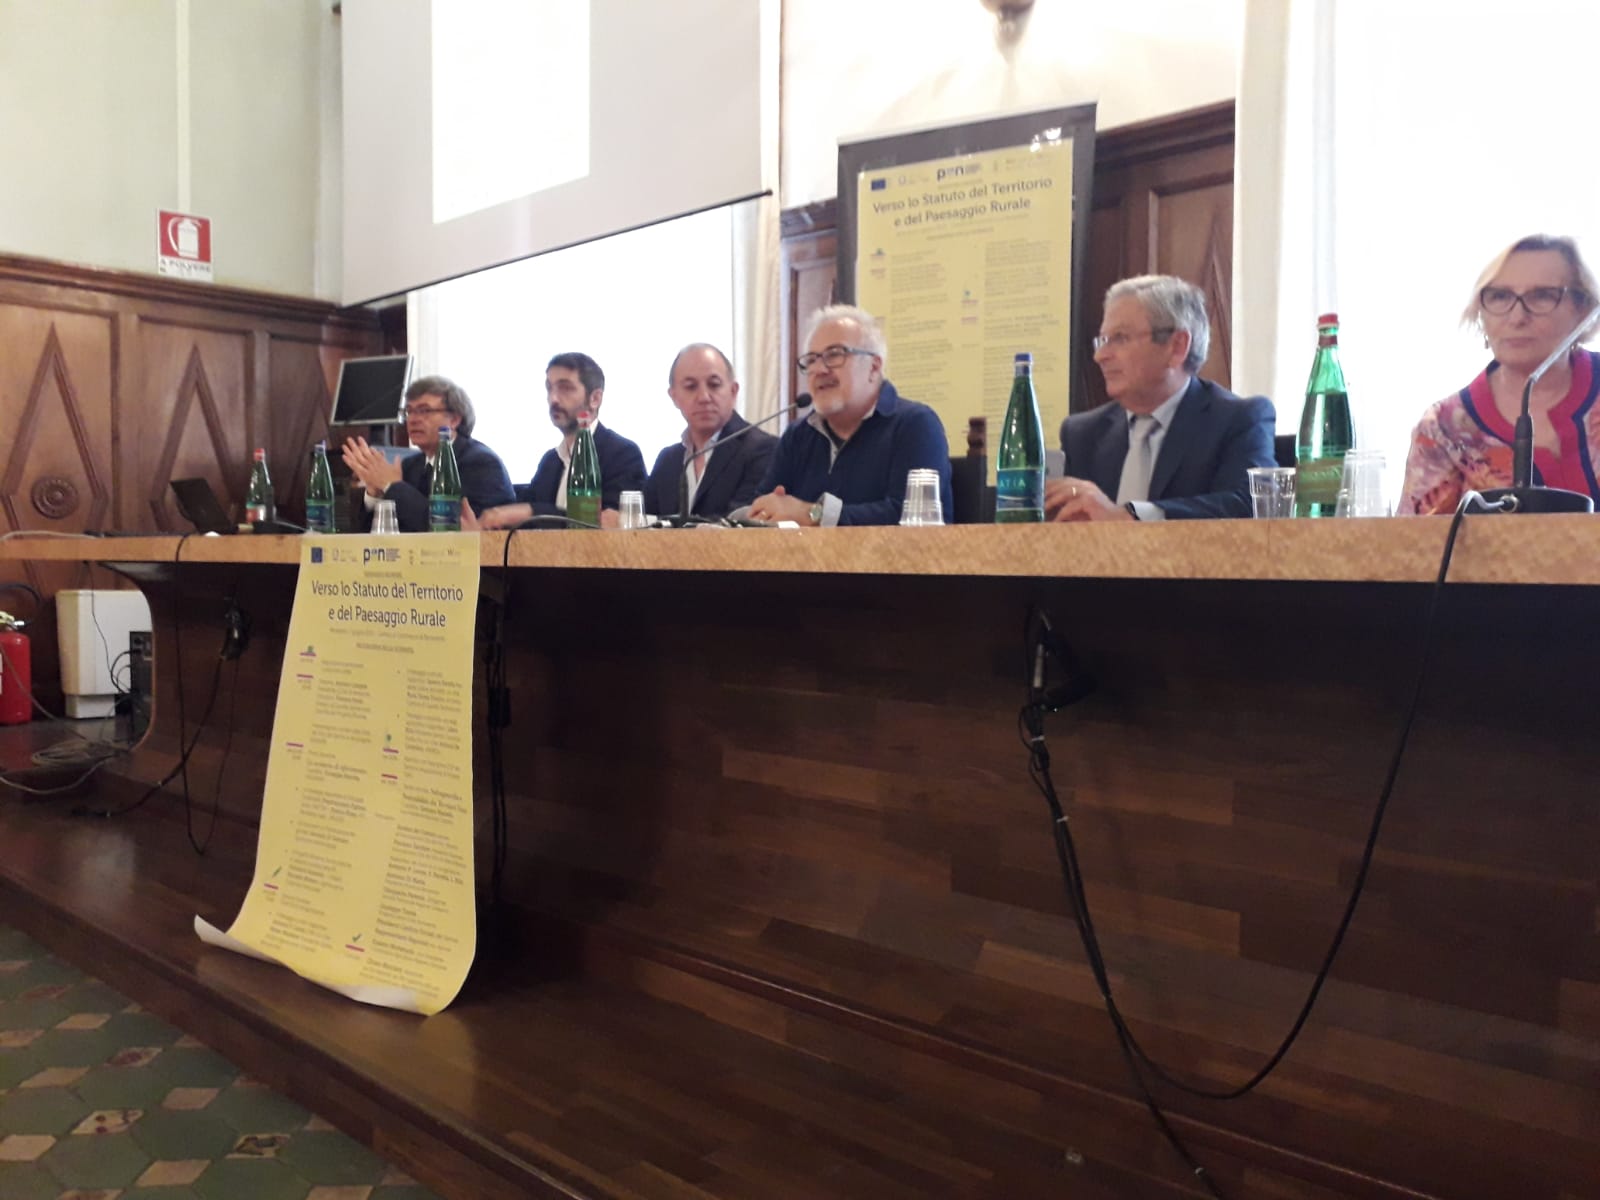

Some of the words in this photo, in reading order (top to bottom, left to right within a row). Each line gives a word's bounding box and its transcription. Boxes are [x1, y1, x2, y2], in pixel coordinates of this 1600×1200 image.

[873, 200, 905, 214] Verso
[908, 196, 920, 209] lo
[922, 189, 966, 207] Statuto
[969, 185, 988, 199] del
[991, 178, 1053, 196] Territorio
[894, 218, 902, 227] e
[904, 213, 922, 226] del
[925, 205, 987, 222] Paesaggio
[990, 197, 1031, 212] Rurale
[312, 580, 339, 596] Verso
[341, 581, 351, 596] lo
[353, 581, 389, 598] Statuto
[391, 583, 408, 599] del
[410, 583, 464, 601] Territorio
[328, 609, 336, 620] e
[337, 605, 352, 621] del
[355, 606, 408, 628] Paesaggio
[411, 609, 446, 627] Rurale
